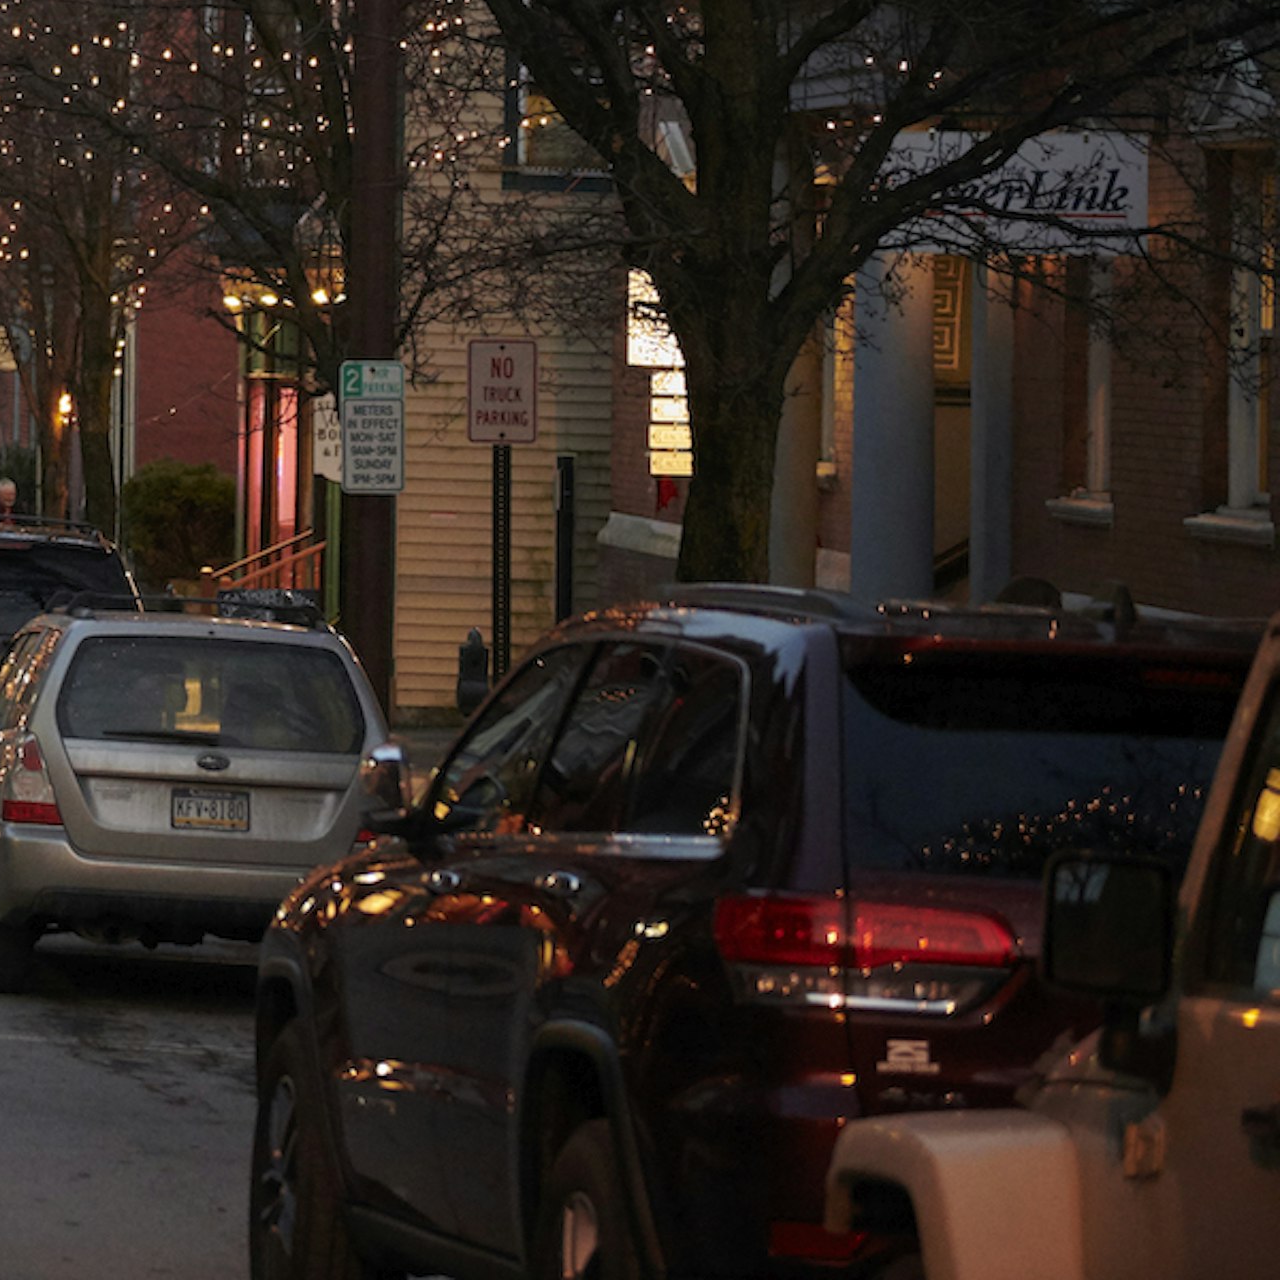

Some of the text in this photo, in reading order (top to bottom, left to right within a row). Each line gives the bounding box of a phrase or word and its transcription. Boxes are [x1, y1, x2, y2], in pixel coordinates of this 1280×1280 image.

[489, 356, 514, 379] NO
[345, 367, 360, 394] 2
[363, 381, 400, 394] PARKING
[482, 386, 523, 403] TRUCK
[353, 404, 394, 416] METERS
[475, 408, 529, 427] PARKING
[347, 418, 358, 429] IN
[361, 418, 399, 430] EFFECT
[353, 457, 393, 470] SUNDAY
